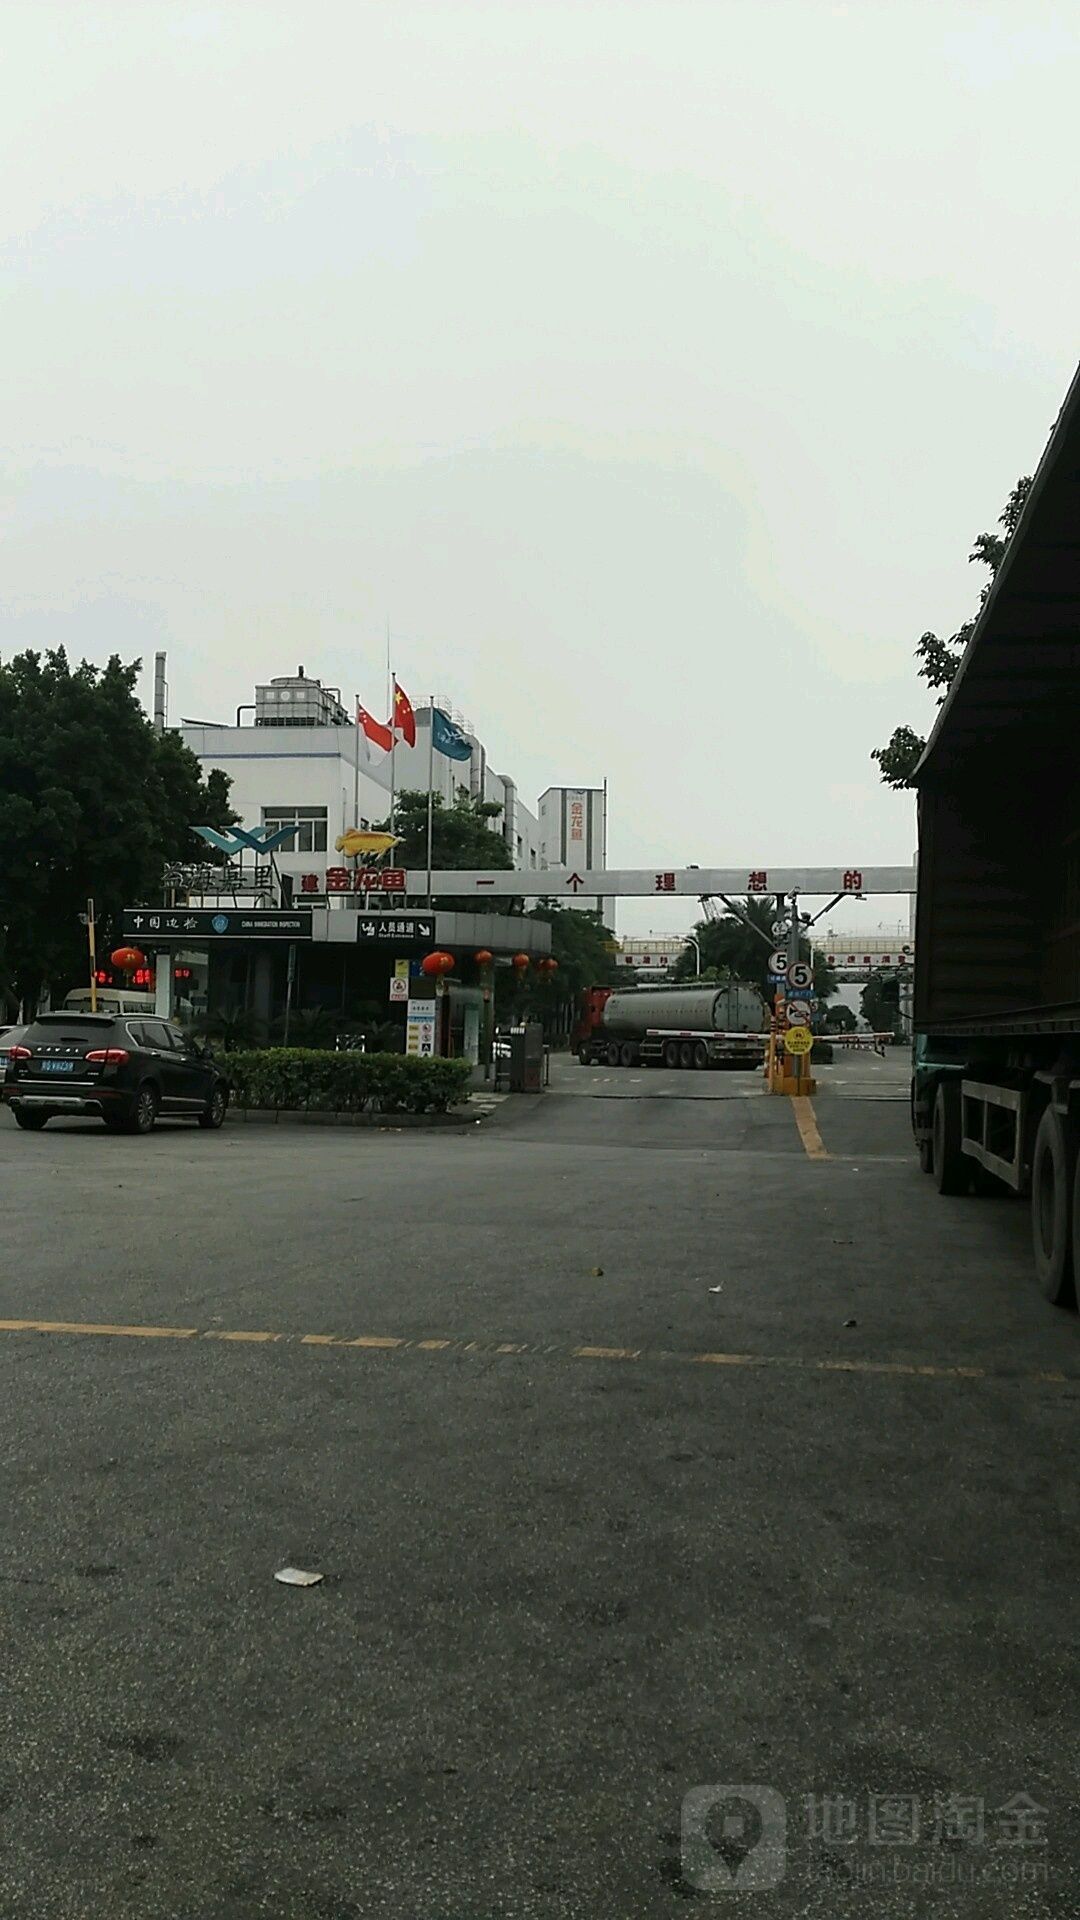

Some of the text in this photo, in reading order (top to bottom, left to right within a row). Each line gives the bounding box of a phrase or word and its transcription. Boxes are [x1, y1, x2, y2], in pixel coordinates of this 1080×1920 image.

[570, 801, 584, 841] 金龙鱼
[161, 861, 275, 891] 益海嘉里
[325, 866, 408, 892] 金龙鱼
[378, 921, 415, 933] 人员通道
[776, 954, 787, 971] 5
[794, 965, 808, 985] 5
